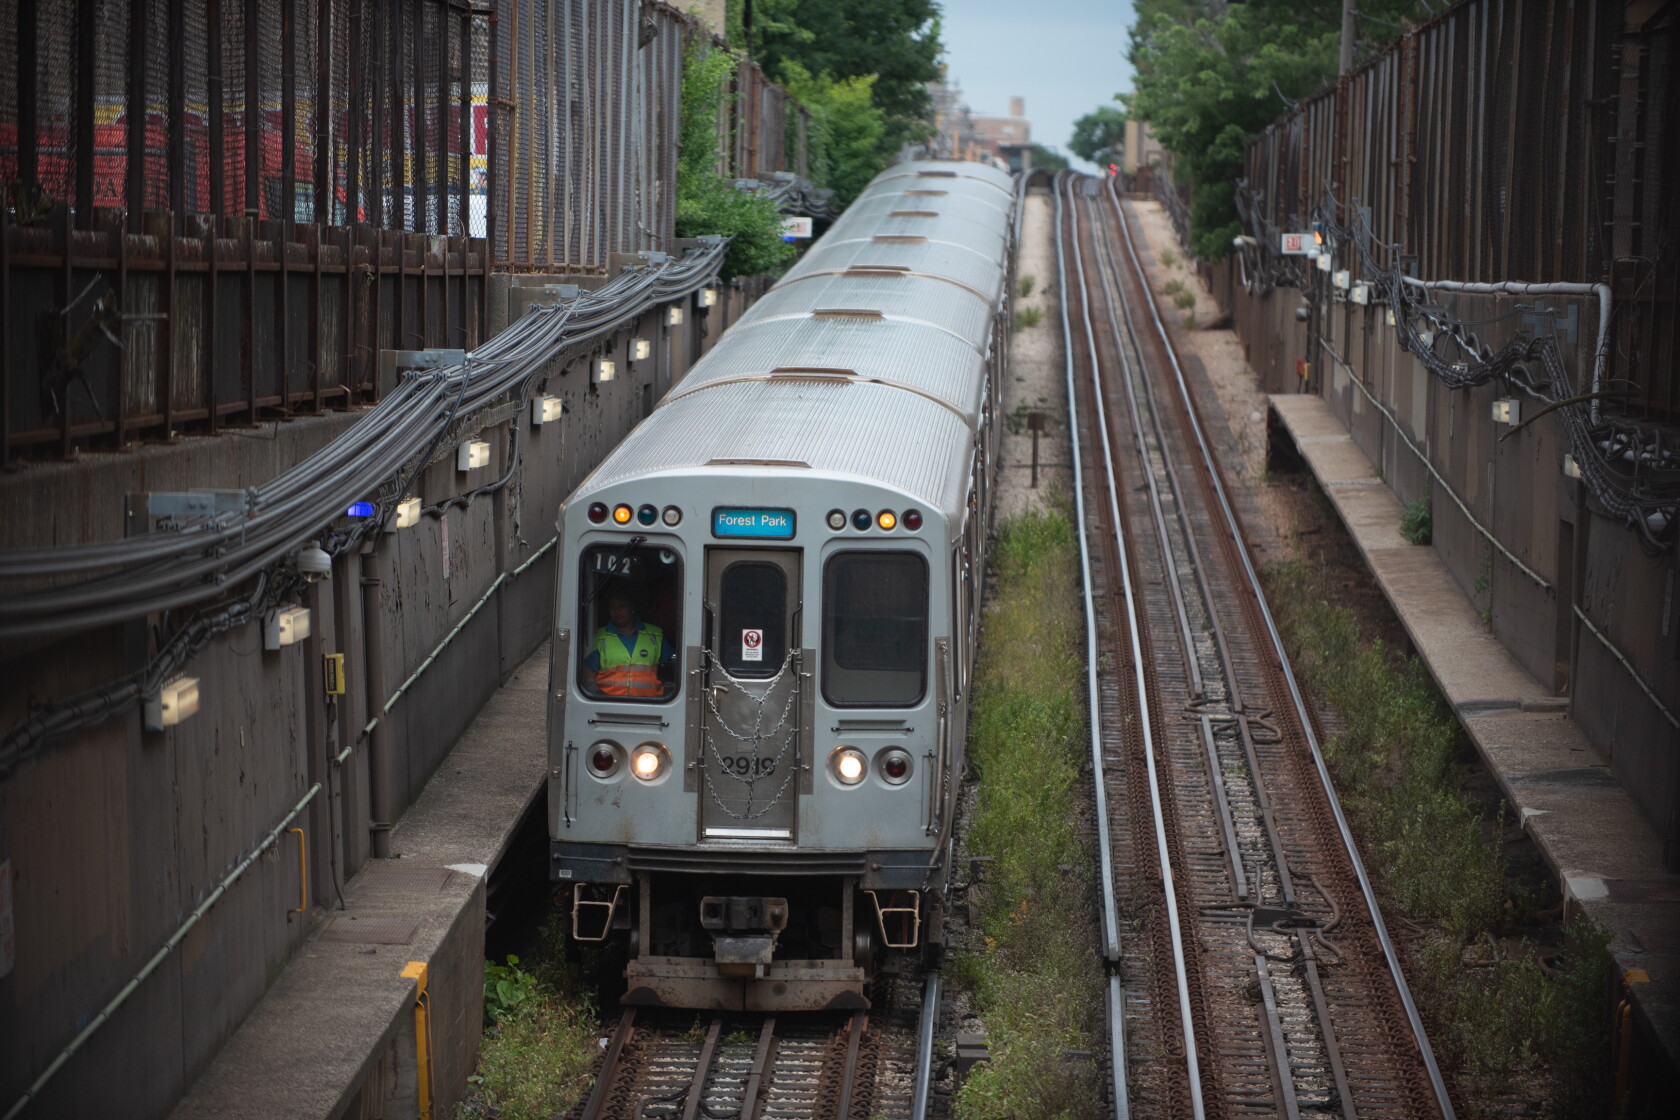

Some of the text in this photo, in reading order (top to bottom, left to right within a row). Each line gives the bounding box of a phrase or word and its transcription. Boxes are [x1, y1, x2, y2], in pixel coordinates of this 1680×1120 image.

[719, 513, 787, 526] Forest Park
[596, 553, 631, 574] 102
[721, 756, 776, 776] 2919
